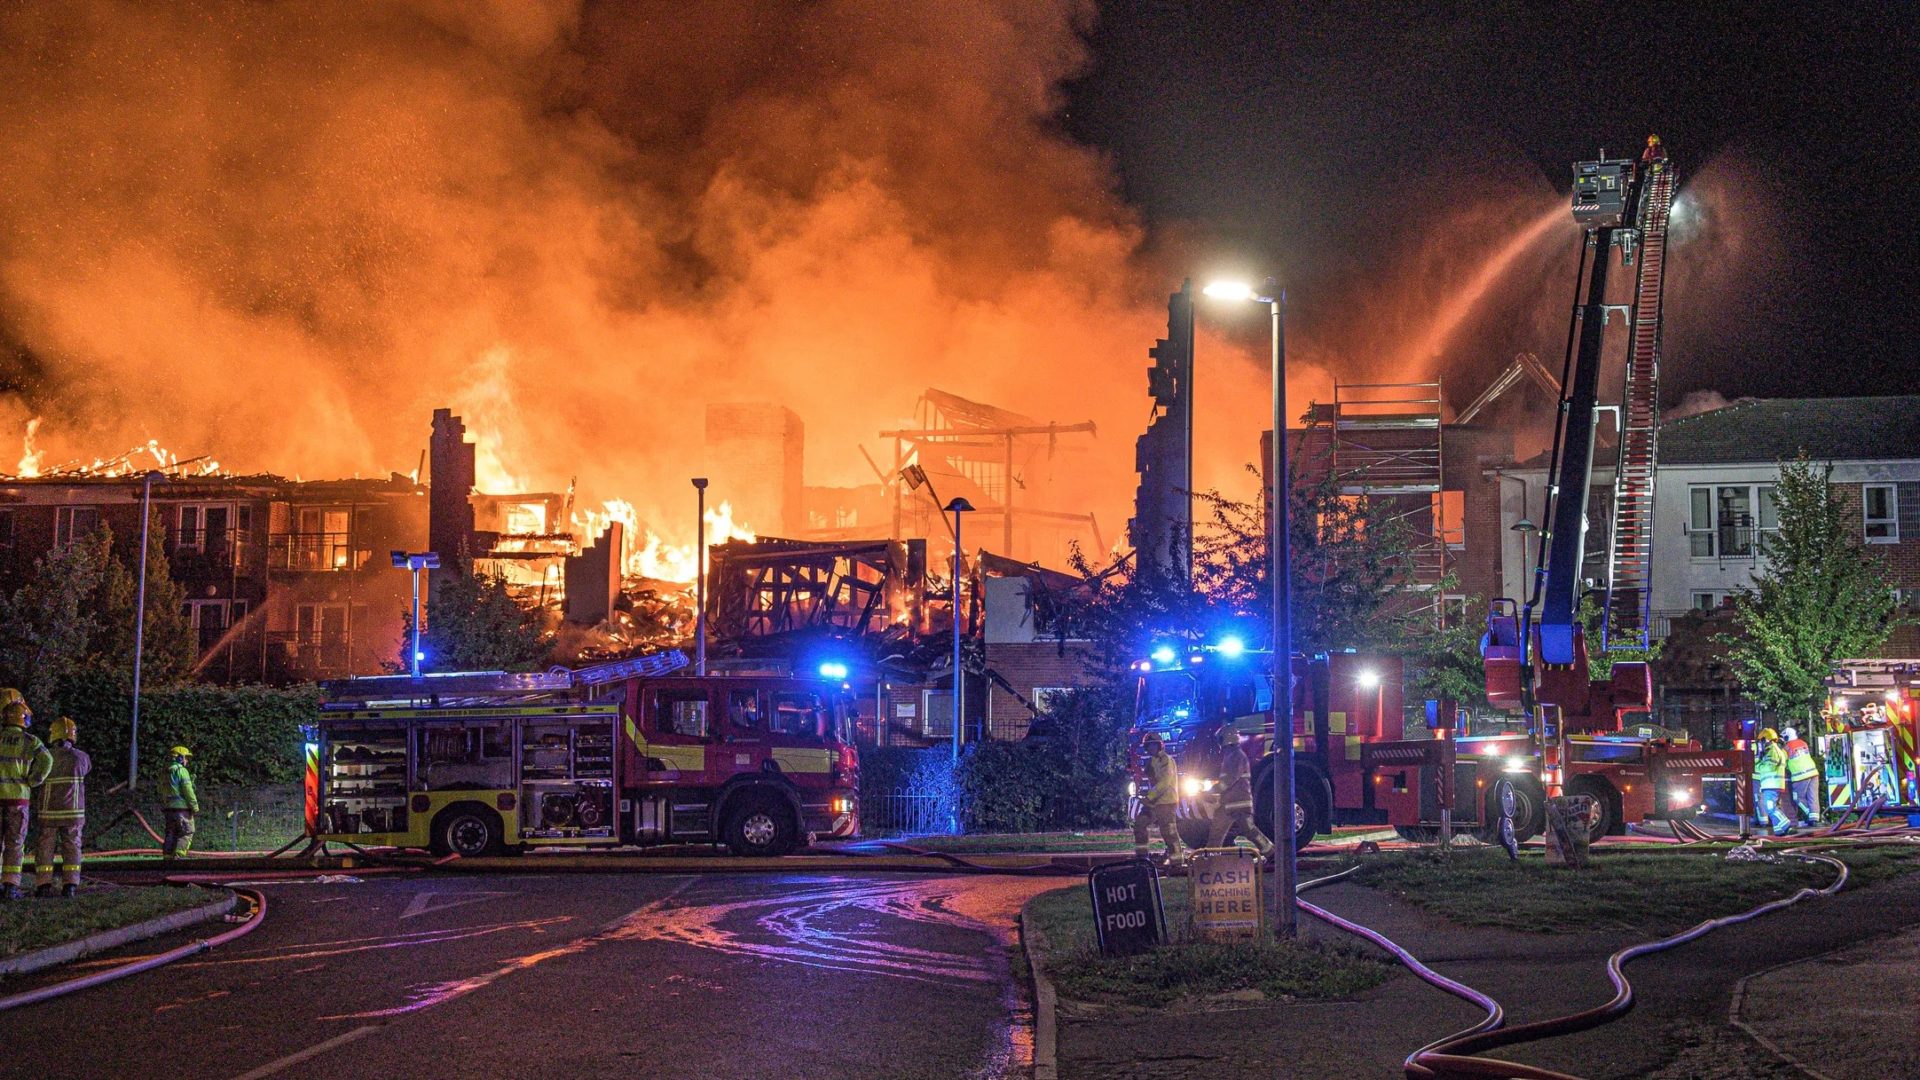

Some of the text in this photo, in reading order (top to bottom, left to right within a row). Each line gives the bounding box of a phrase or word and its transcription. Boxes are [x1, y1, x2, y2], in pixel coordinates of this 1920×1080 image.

[1199, 871, 1250, 885] CASH
[1106, 884, 1137, 904] HOT
[1200, 887, 1250, 898] MACHINE
[1201, 900, 1252, 914] HERE
[1106, 910, 1146, 931] FOOD
